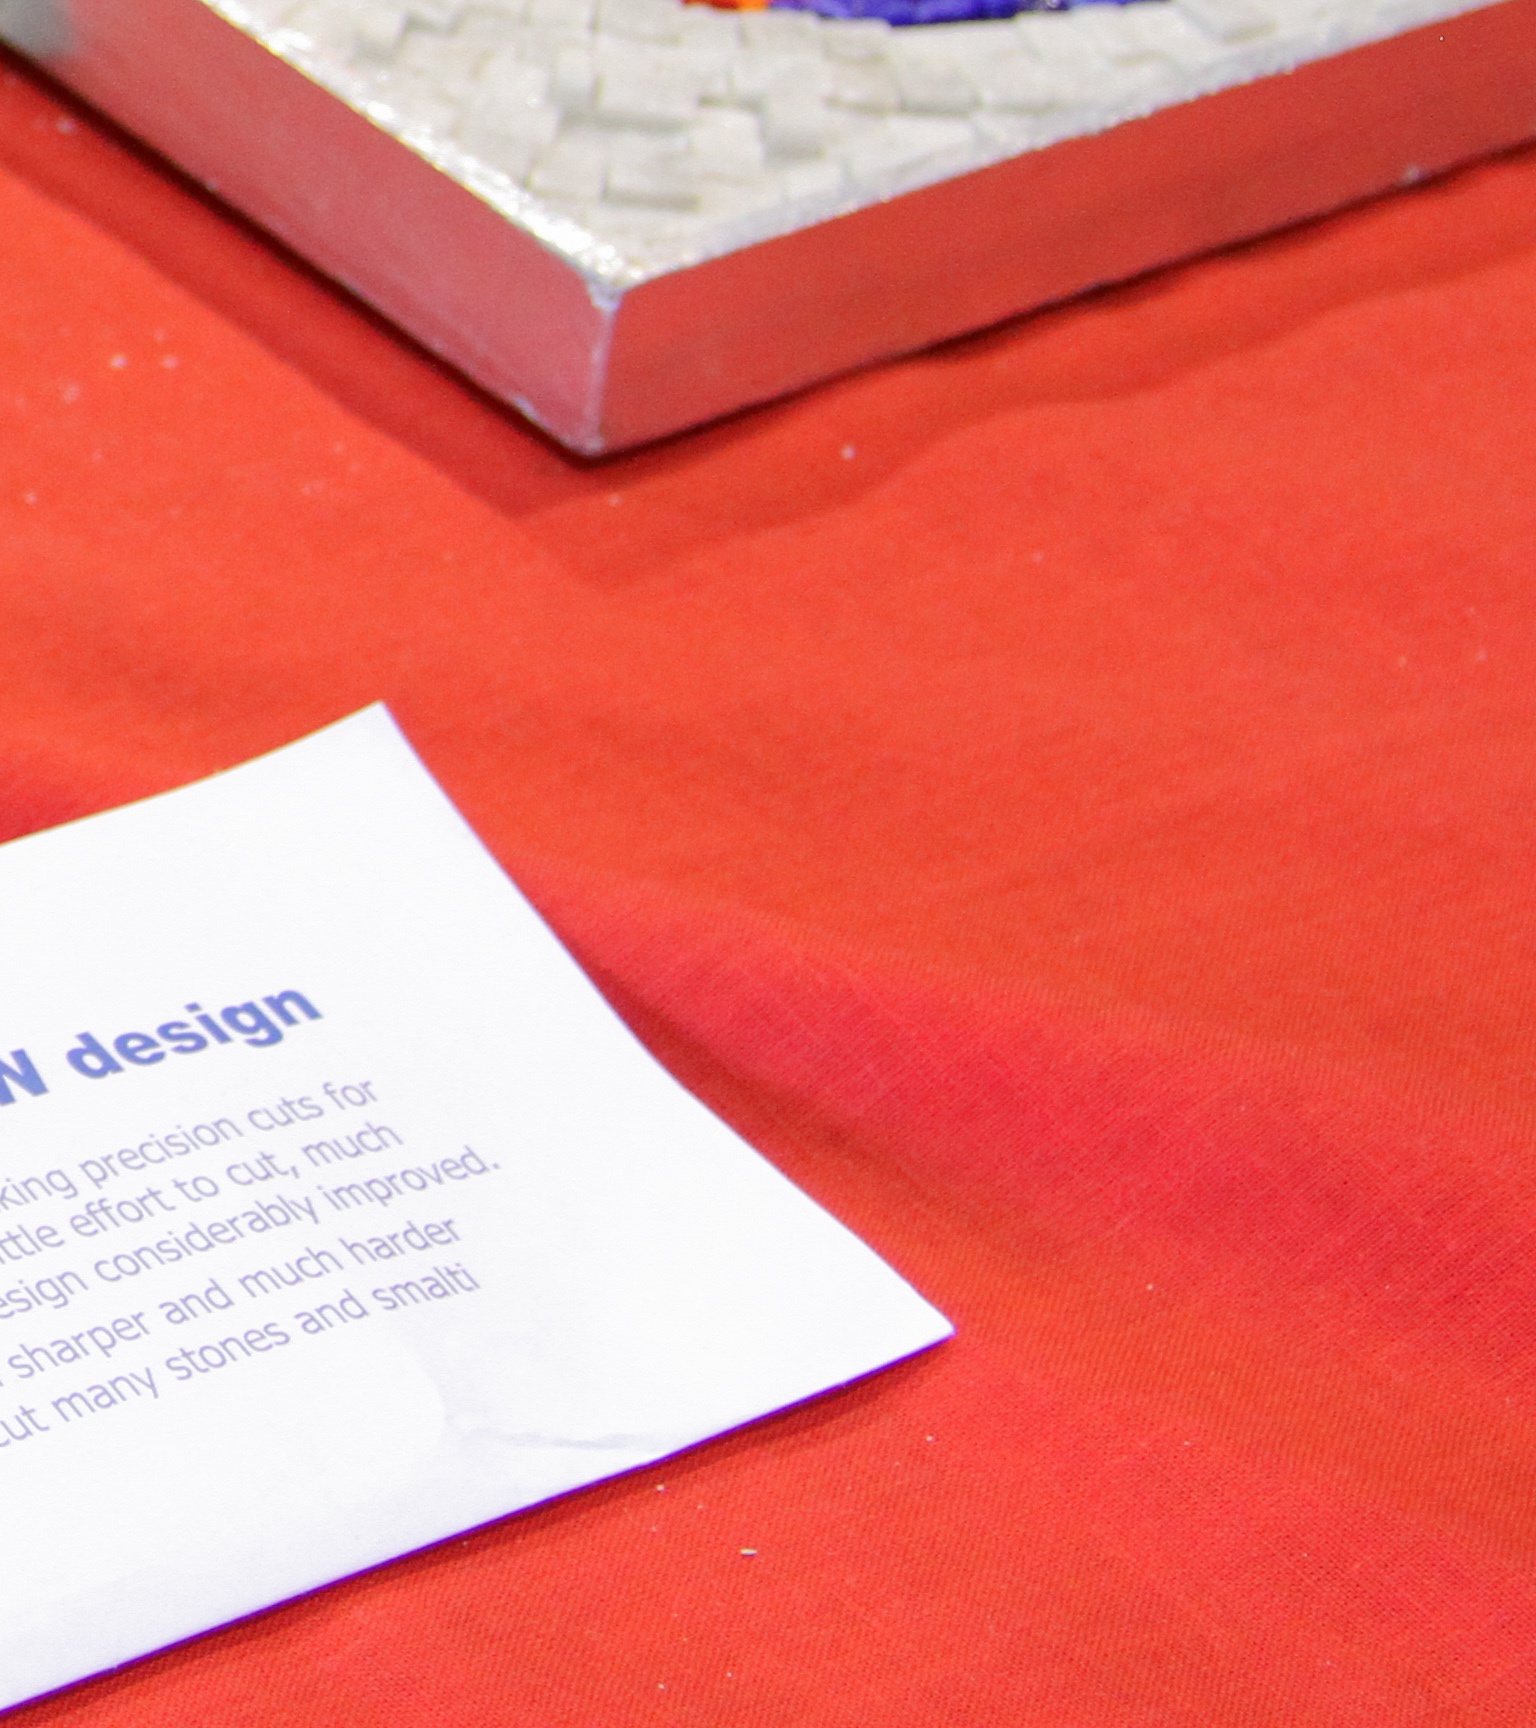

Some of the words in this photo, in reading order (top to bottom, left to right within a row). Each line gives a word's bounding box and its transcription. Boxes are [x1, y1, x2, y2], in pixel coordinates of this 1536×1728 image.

[67, 990, 322, 1078] design
[70, 1189, 175, 1236] effort
[174, 1177, 219, 1201] to
[227, 1153, 298, 1185] cut,
[302, 1123, 401, 1165] much
[80, 1119, 242, 1188] precision
[248, 1097, 324, 1130] cuts
[323, 1079, 377, 1109] for
[94, 1196, 318, 1282] considerably
[318, 1147, 501, 1209] improved.
[8, 1312, 148, 1378] sharper
[159, 1279, 234, 1324] and
[239, 1248, 343, 1297] much
[340, 1216, 460, 1263] harder
[52, 1368, 158, 1421] many
[166, 1323, 290, 1380] stones
[295, 1290, 368, 1334] and
[372, 1262, 480, 1311] smalti
